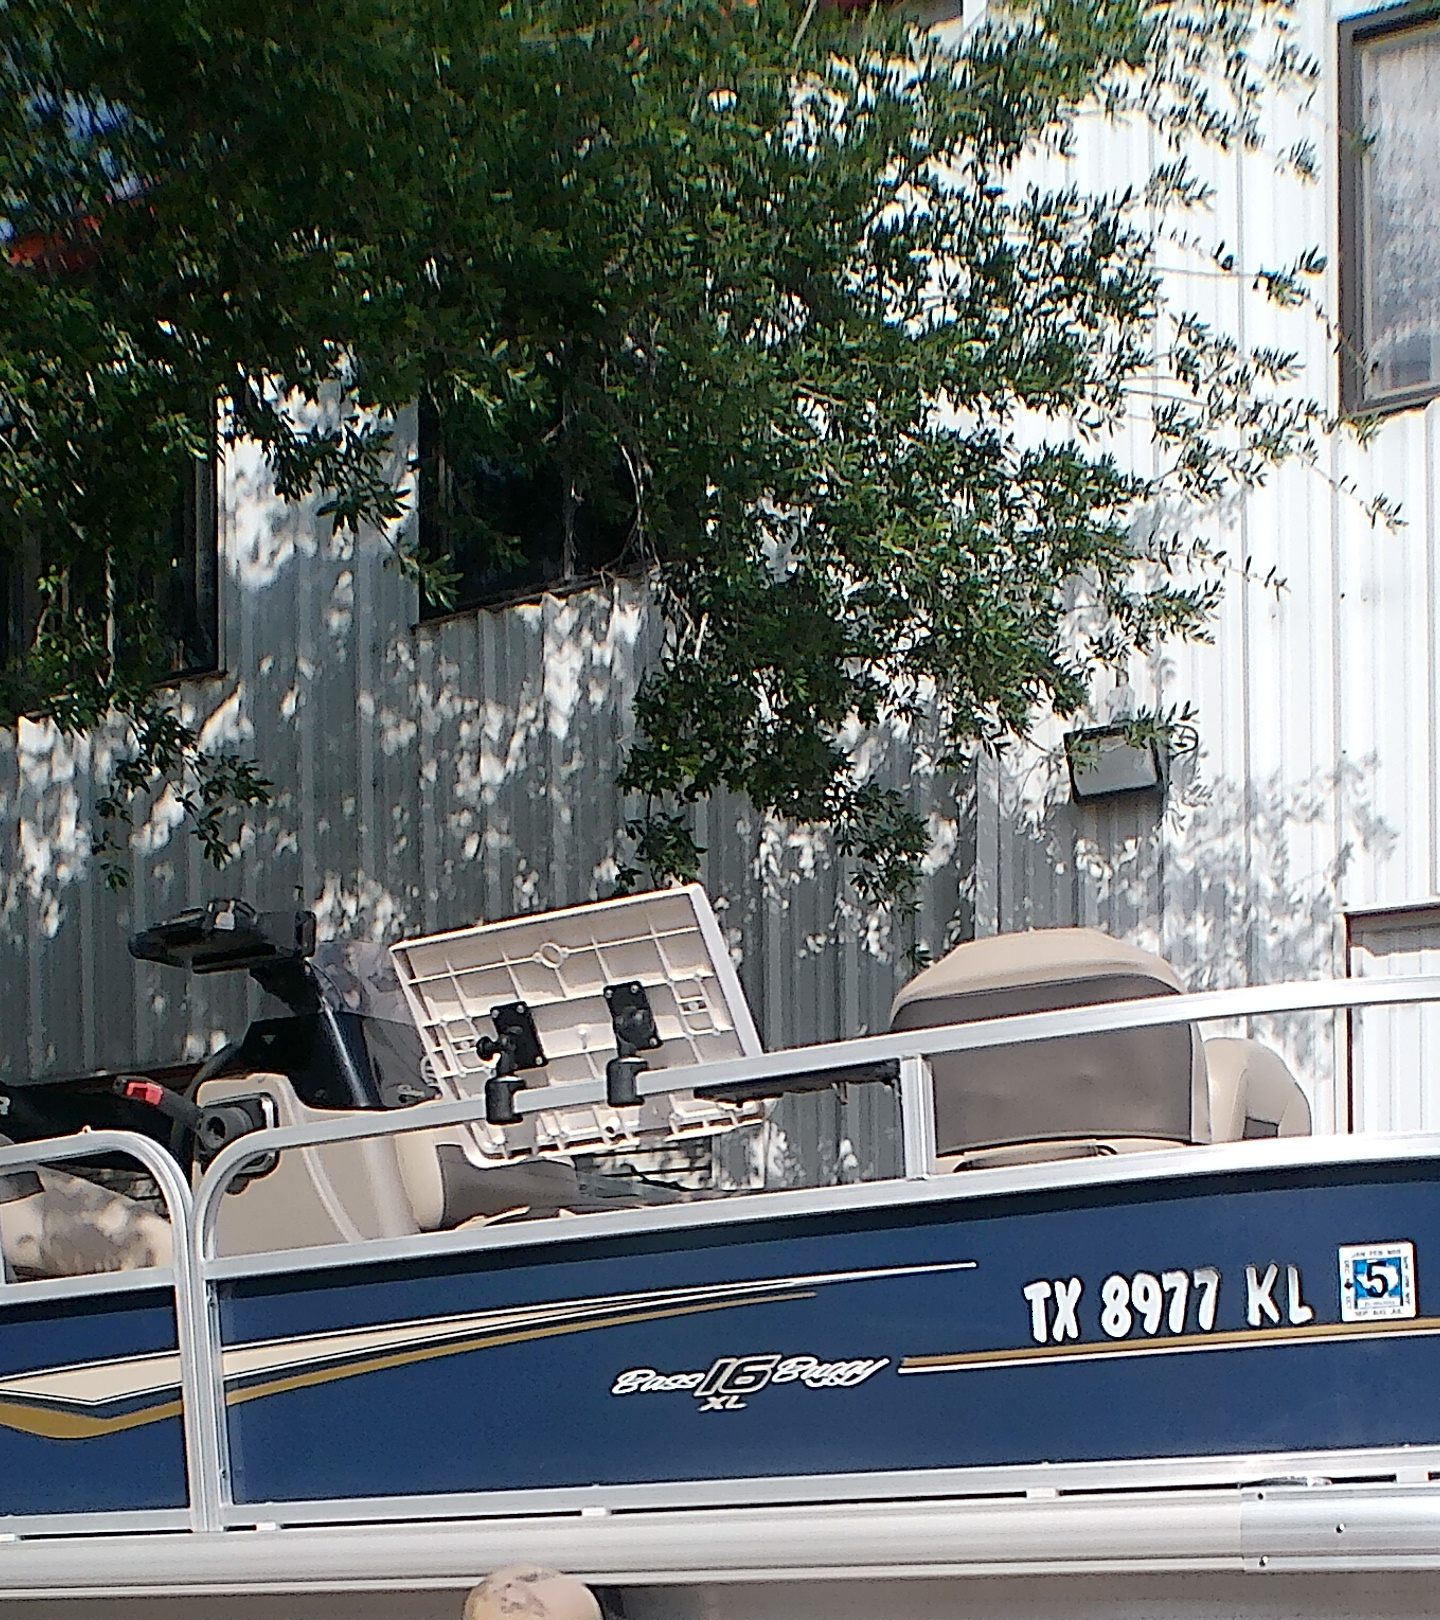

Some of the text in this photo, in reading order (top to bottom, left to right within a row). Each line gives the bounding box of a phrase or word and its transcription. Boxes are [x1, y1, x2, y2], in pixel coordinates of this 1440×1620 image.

[1366, 1260, 1389, 1298] 5
[1023, 1263, 1314, 1343] TX 8977 KL
[611, 1354, 890, 1397] Bass 16 Buggy
[697, 1395, 748, 1412] XL
